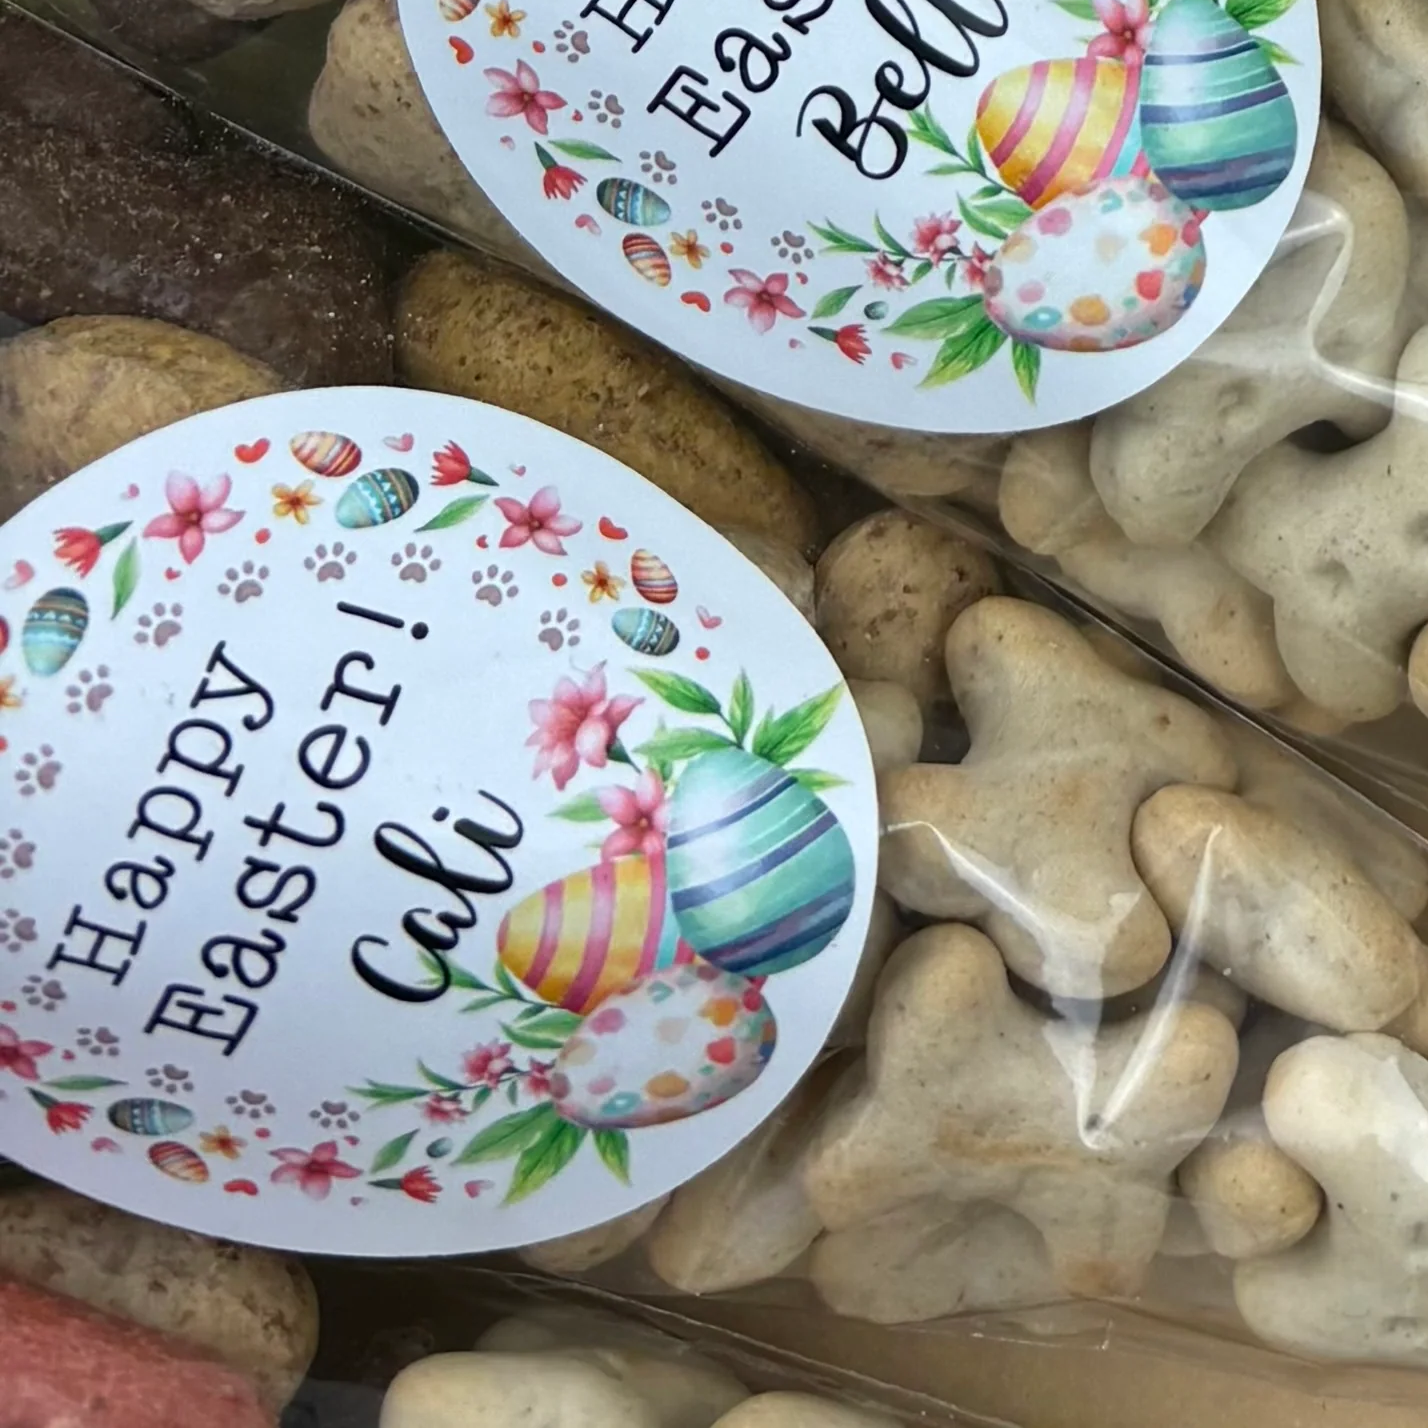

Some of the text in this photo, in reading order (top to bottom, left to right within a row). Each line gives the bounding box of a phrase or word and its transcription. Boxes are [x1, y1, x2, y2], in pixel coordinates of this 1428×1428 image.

[46, 640, 274, 986] Happy
[143, 601, 429, 1056] Easter!
[351, 790, 523, 1003] Cali
